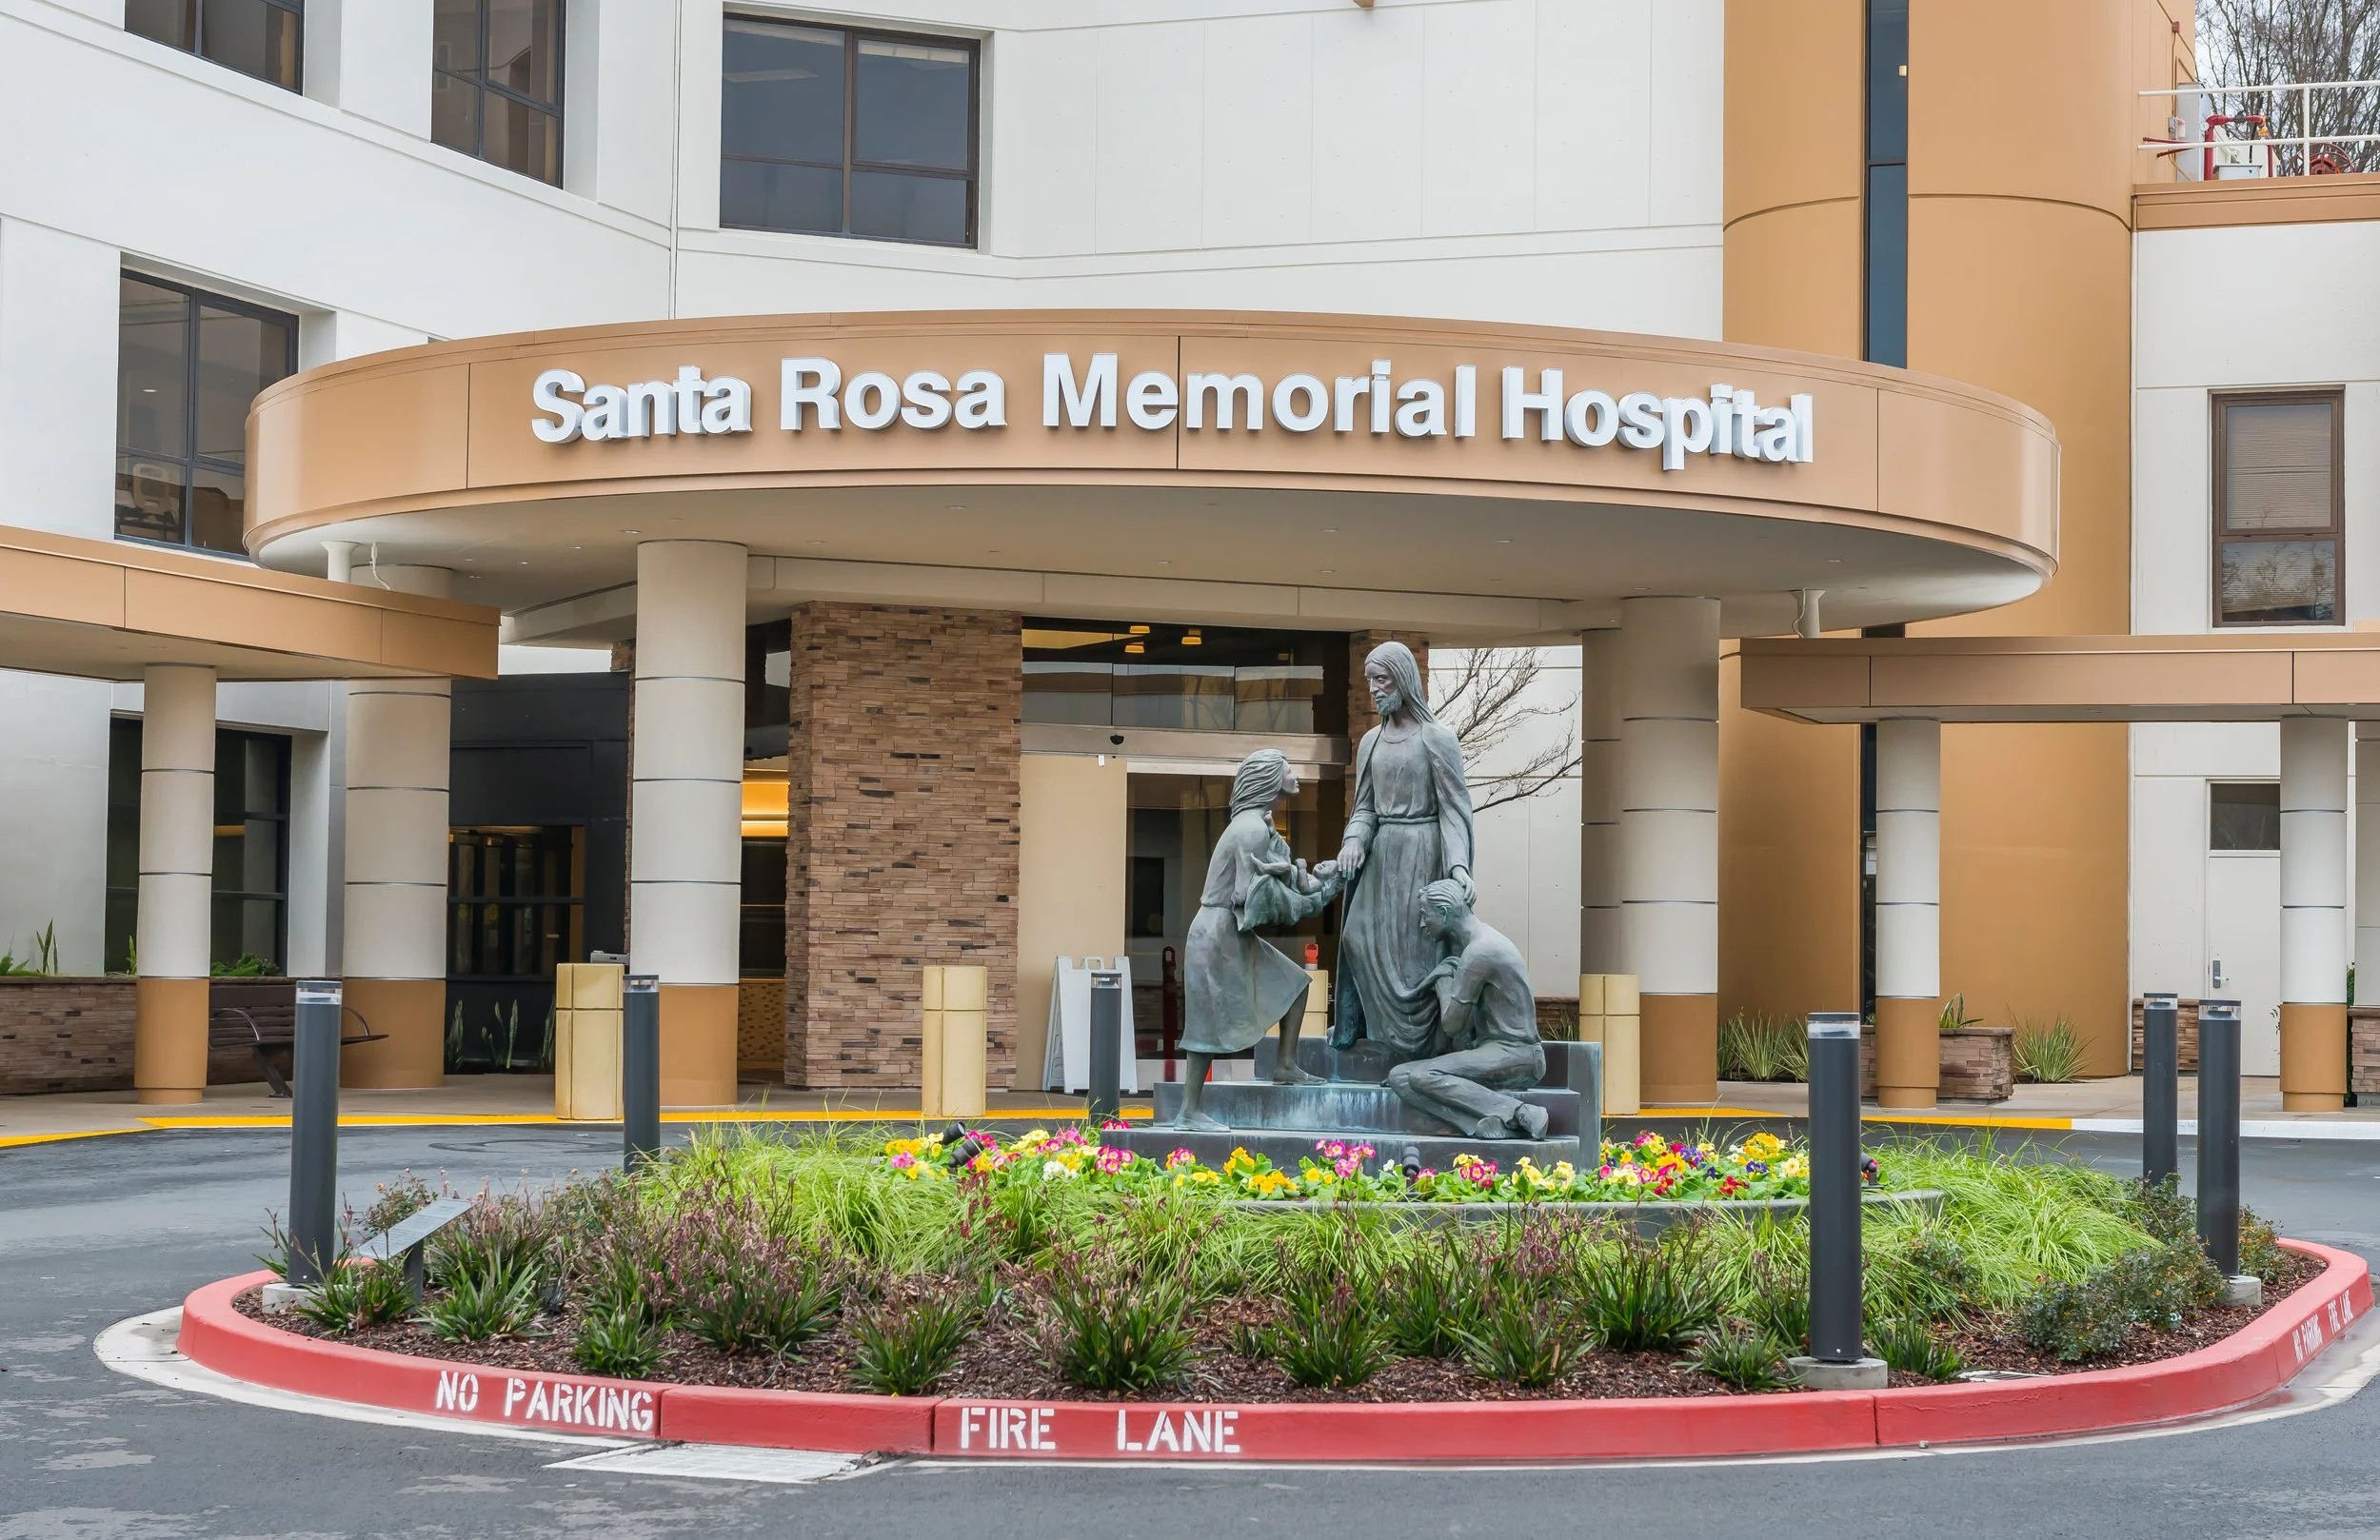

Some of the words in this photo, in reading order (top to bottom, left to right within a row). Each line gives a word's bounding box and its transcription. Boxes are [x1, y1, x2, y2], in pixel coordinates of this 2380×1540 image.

[532, 365, 753, 444] Santa
[780, 357, 1008, 431] Rosa
[1042, 352, 1478, 438] Memorial
[1501, 365, 1813, 470] Hospital
[436, 1371, 479, 1412] NO
[504, 1377, 654, 1431] PARKING
[961, 1407, 1056, 1450] FIRE
[1117, 1409, 1240, 1453] LANE
